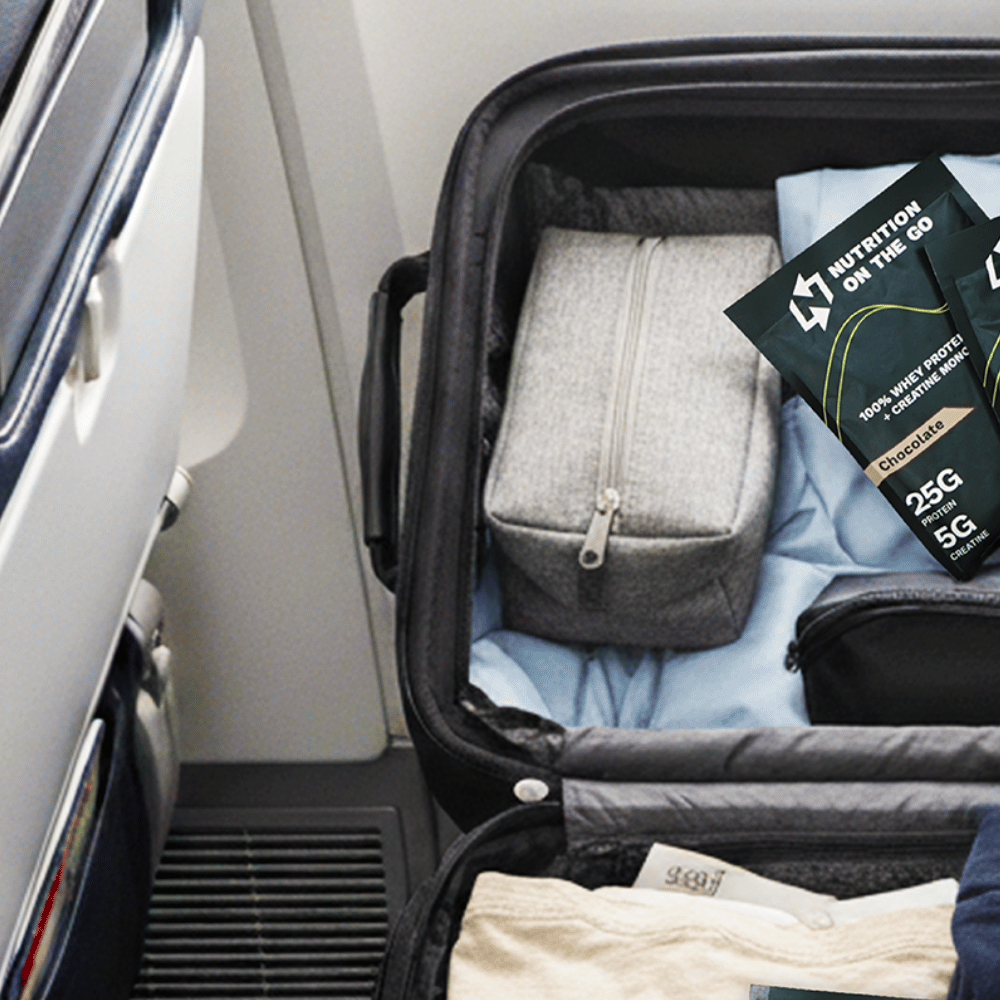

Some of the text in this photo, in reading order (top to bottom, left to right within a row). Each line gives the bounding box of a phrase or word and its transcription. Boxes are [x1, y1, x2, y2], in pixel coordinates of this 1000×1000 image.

[828, 200, 922, 280] NUTRITION
[843, 216, 934, 292] ON THE GO
[858, 394, 892, 422] 100%
[890, 366, 924, 398] WHEY
[891, 372, 941, 414] CREATINE
[878, 418, 944, 473] Chocolate
[905, 467, 964, 516] 25G
[921, 499, 958, 528] PROTEIN
[933, 514, 979, 550] 5G
[950, 530, 990, 562] CREATINE
